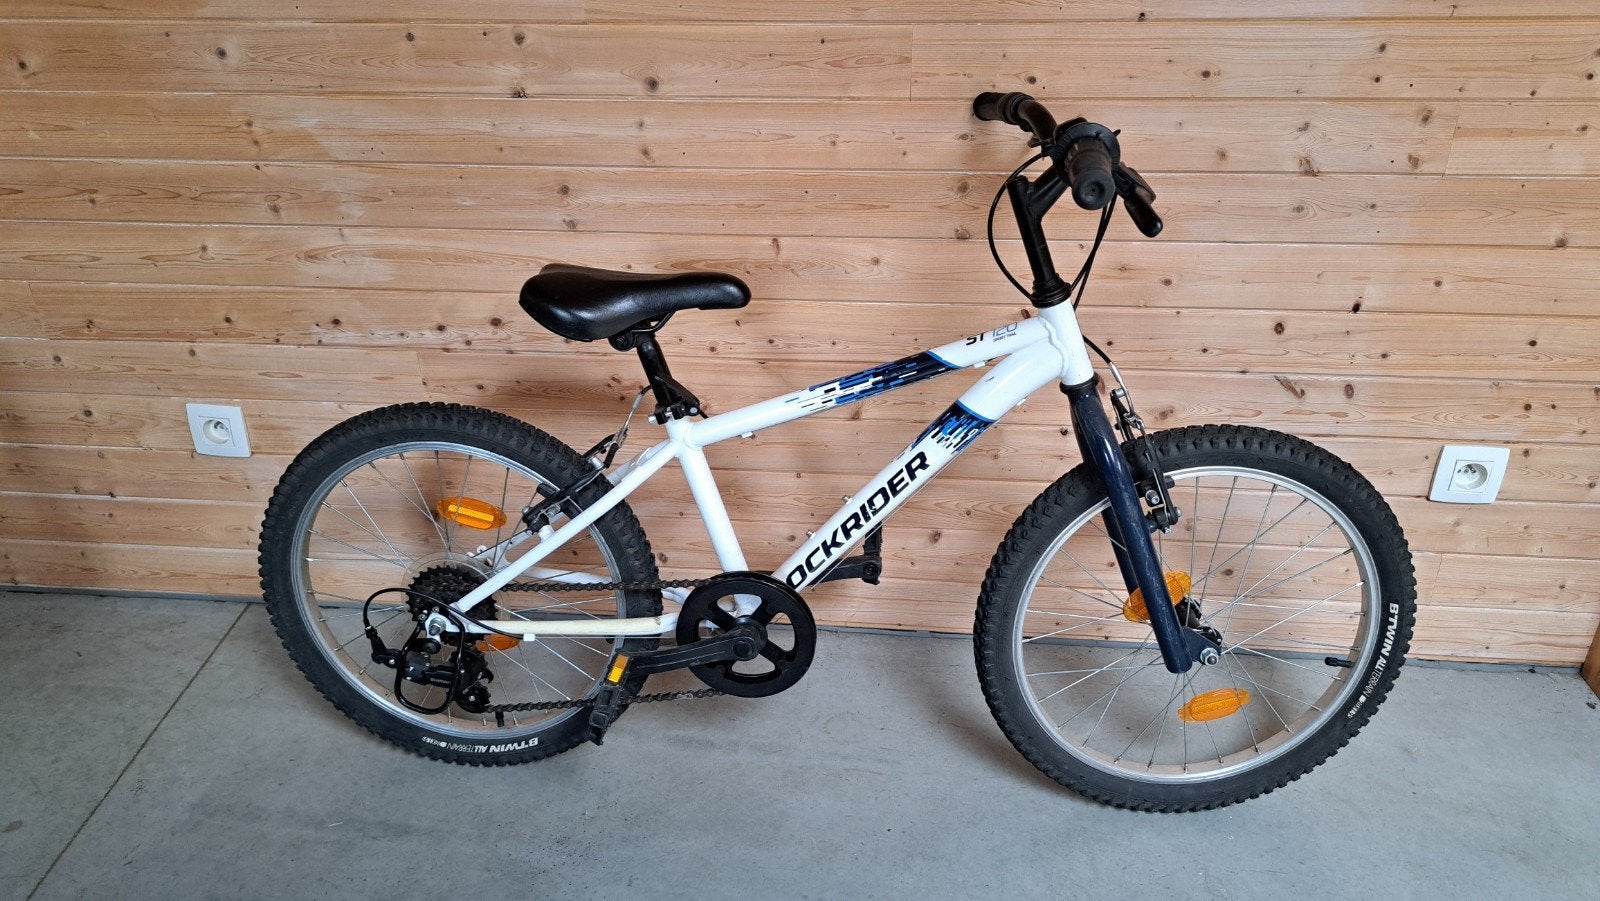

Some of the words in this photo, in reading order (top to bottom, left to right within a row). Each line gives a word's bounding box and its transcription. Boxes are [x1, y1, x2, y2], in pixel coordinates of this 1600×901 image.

[966, 332, 985, 346] ST
[992, 321, 1018, 337] 120
[785, 451, 931, 589] OCKRIDER
